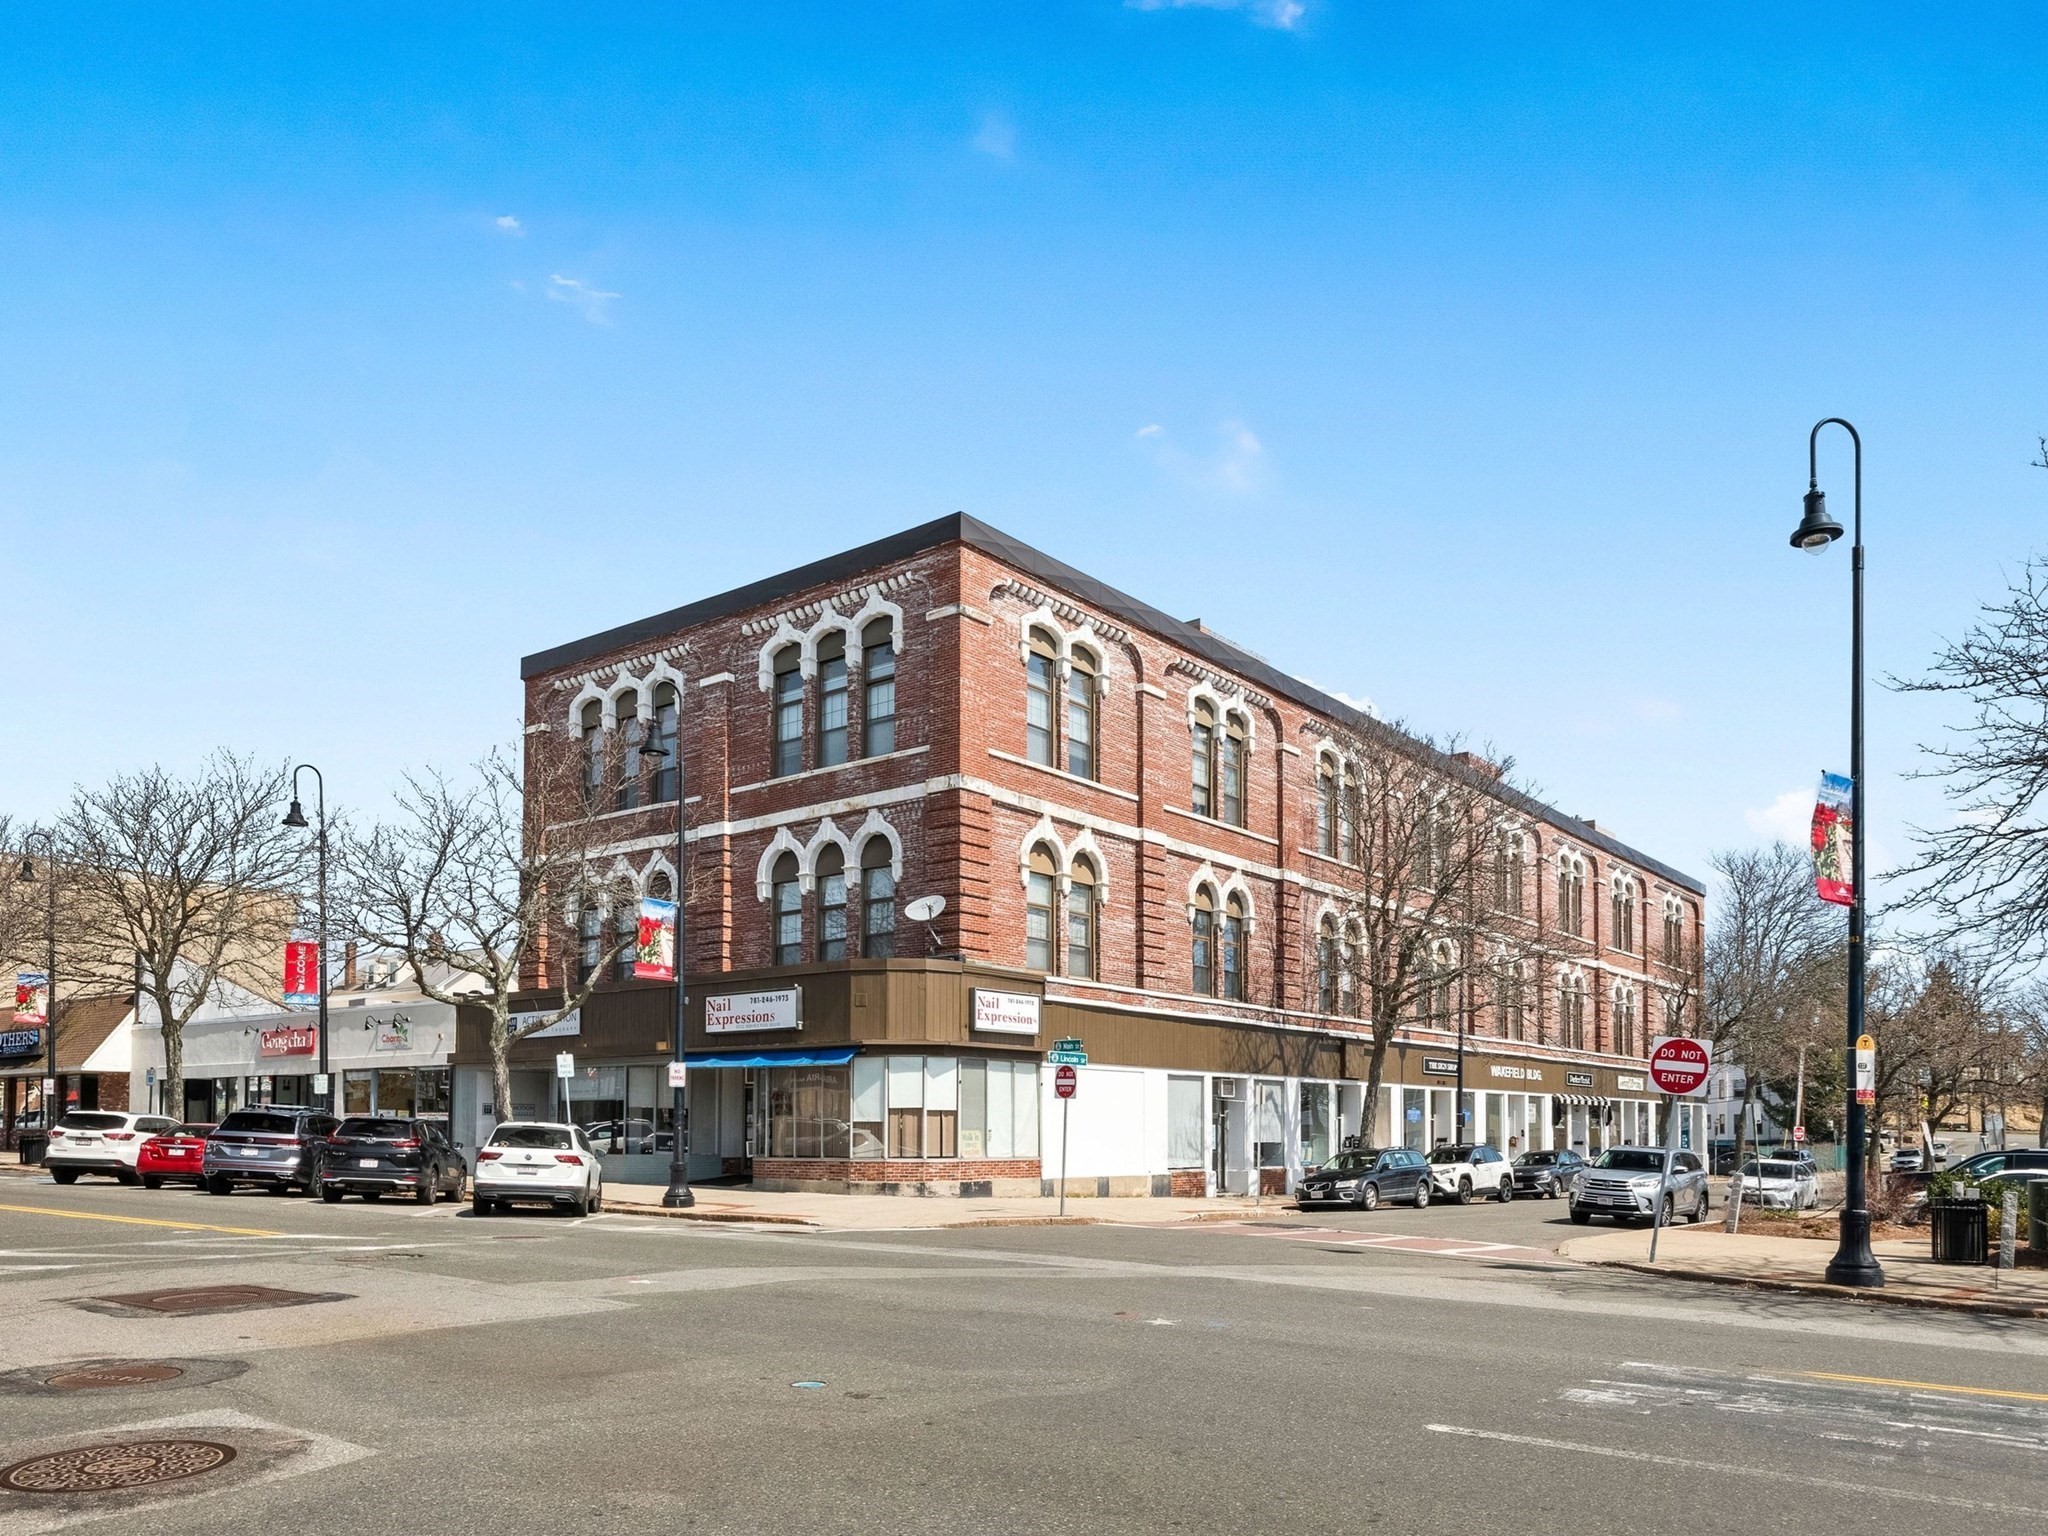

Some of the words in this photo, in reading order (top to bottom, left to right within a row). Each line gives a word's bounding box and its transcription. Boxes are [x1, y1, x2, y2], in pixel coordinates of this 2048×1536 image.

[707, 998, 731, 1012] Nail
[750, 994, 789, 1004] 781-246-1973
[977, 996, 999, 1009] Nail
[707, 1010, 776, 1029] Expressions
[977, 1009, 1037, 1025] Expressions
[261, 1033, 288, 1053] Gong
[288, 1031, 306, 1048] cha
[1060, 1055, 1079, 1063] Lincoln
[1661, 1048, 1675, 1058] DO
[1681, 1050, 1702, 1060] NOT
[1490, 1065, 1525, 1079] WAKEFIELD
[1661, 1073, 1694, 1084] ENTER
